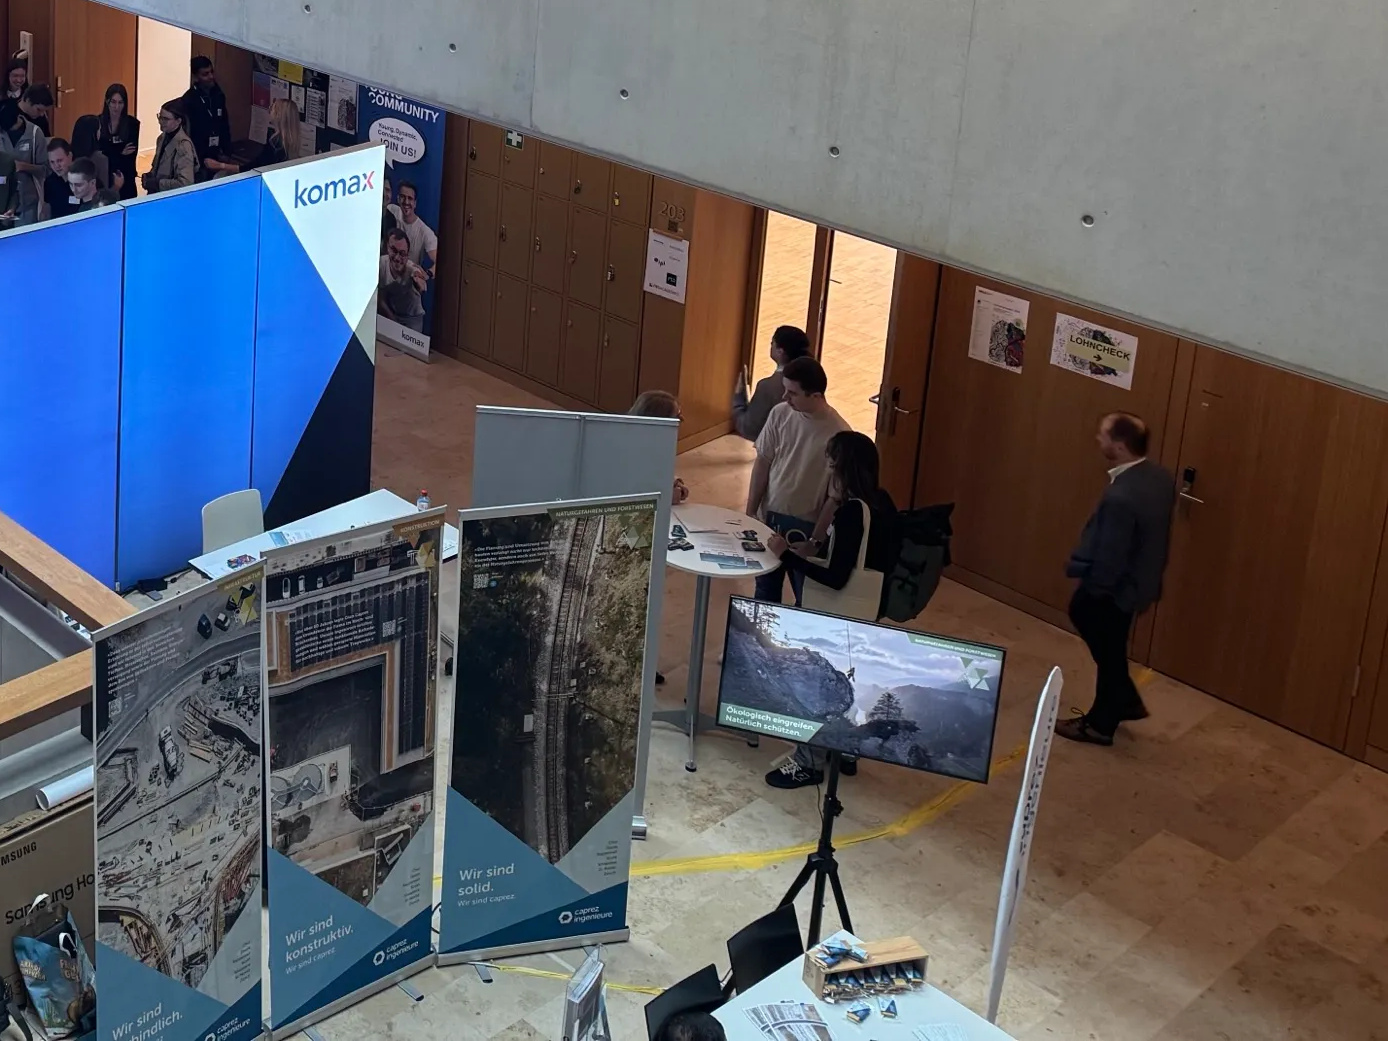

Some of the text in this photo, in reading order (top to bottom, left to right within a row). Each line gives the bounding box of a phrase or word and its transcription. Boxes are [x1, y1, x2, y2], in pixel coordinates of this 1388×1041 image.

[369, 92, 439, 123] COMMUNITY
[400, 146, 417, 159] US!
[294, 170, 375, 209] komax
[659, 201, 686, 222] 203
[401, 330, 425, 348] komax
[1069, 334, 1131, 361] LOHNCHECK
[555, 508, 603, 518] NATURGEFAHREN
[725, 714, 802, 737] Natürlich schützen.
[726, 705, 815, 731] Ökologisch eingreifen.
[459, 863, 515, 881] Wir sind
[458, 881, 494, 896] solid.
[457, 899, 471, 908] Wir
[472, 896, 488, 906] sind
[574, 906, 600, 917] caprez
[573, 911, 613, 924] ingenieure
[285, 915, 334, 946] Wir sind
[285, 924, 354, 963] konstruktiv.
[386, 939, 408, 953] caprez
[386, 941, 419, 960] ingenieure
[285, 963, 297, 975] Wir
[298, 955, 312, 969] sind
[112, 1002, 162, 1041] Wir sind
[216, 1017, 239, 1034] caprez
